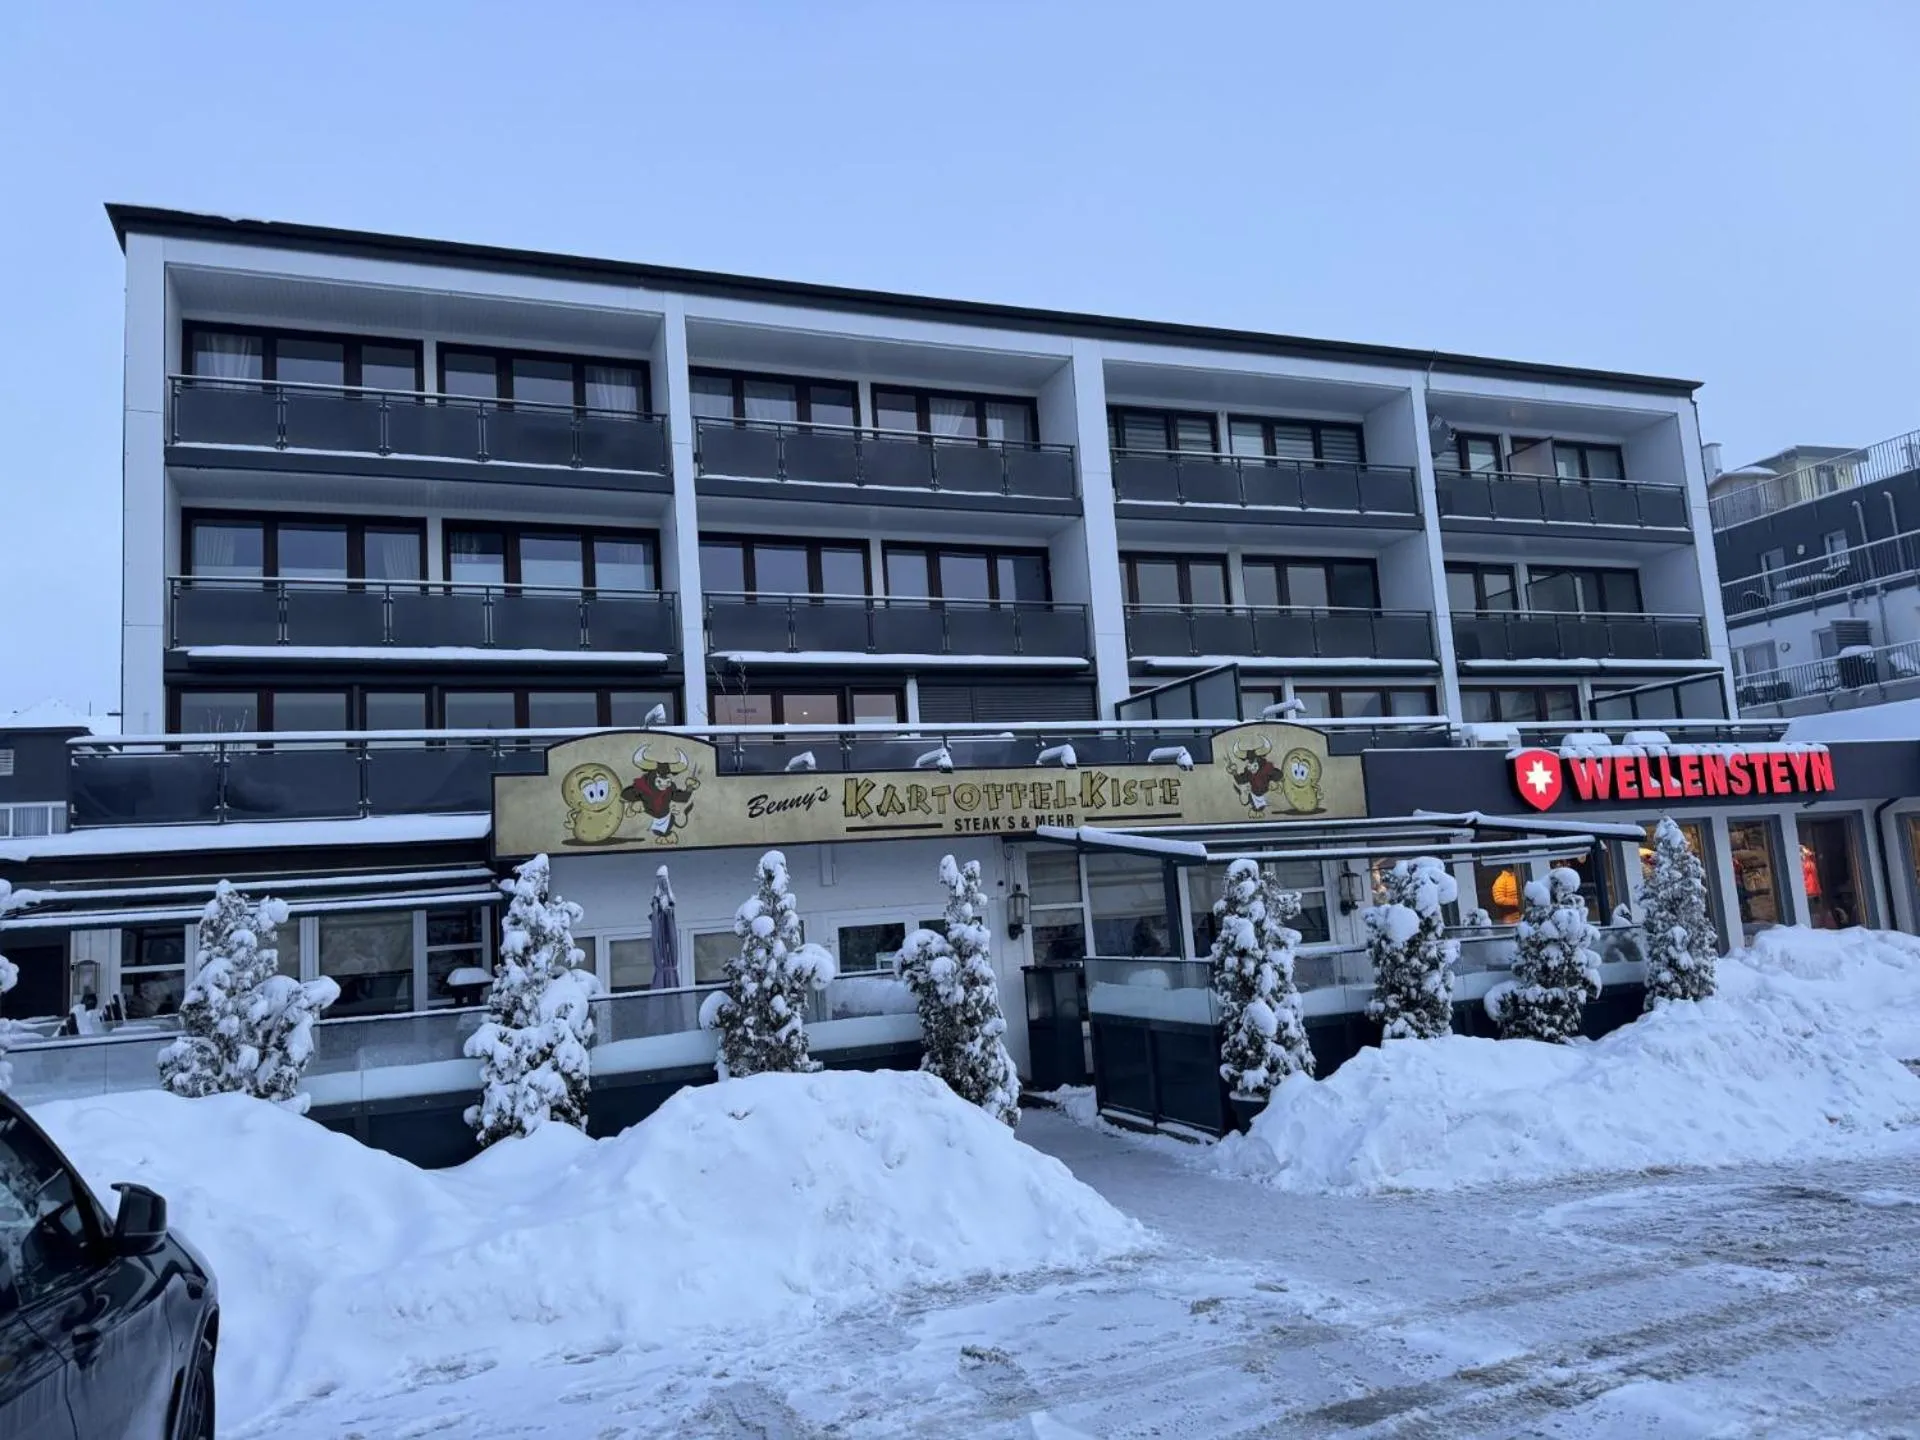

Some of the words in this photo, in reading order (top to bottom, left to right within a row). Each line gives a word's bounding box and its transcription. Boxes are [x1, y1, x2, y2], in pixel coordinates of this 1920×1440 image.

[1568, 751, 1835, 800] WELLENSTEYN
[1021, 815, 1030, 829] &
[1035, 813, 1075, 829] MEHR
